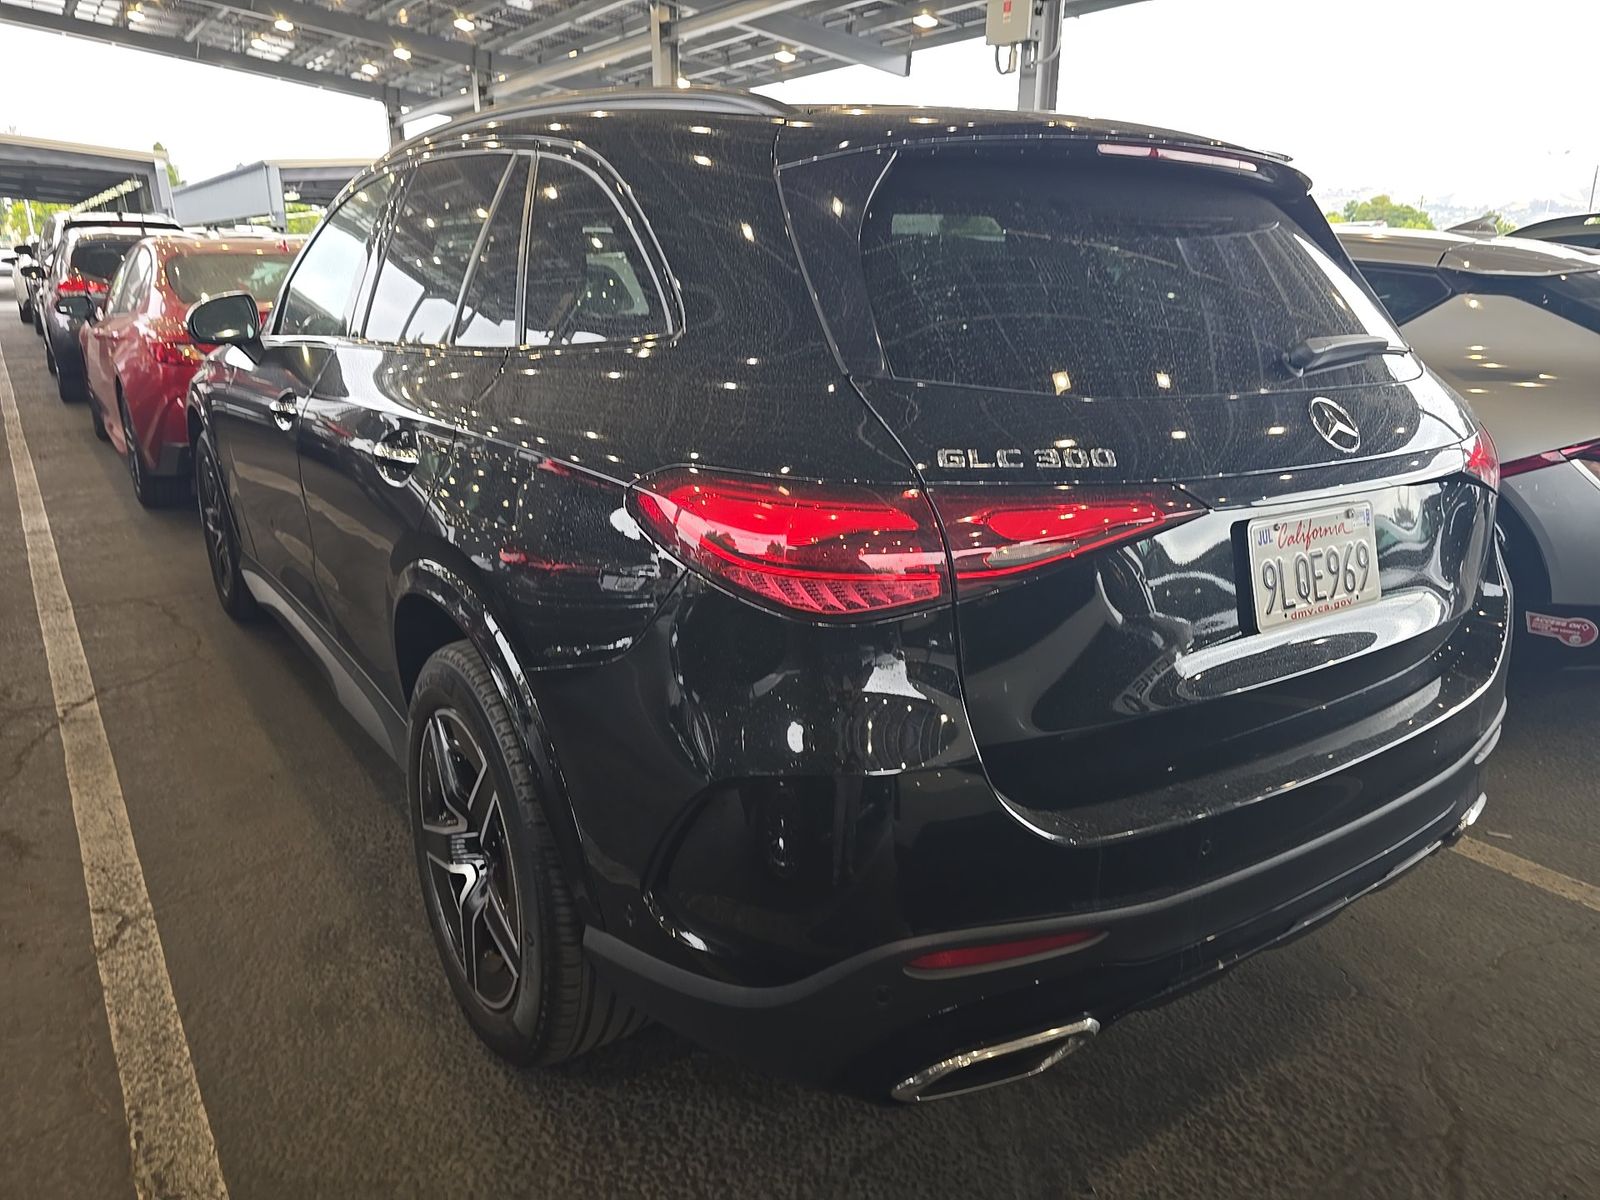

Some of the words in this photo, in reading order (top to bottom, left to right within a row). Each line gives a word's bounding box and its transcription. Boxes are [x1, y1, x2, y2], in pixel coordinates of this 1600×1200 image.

[937, 448, 1024, 468] GLC
[1034, 447, 1118, 468] 300
[1257, 528, 1274, 546] JUL
[1277, 518, 1352, 552] California
[1261, 539, 1370, 616] 9LQE969
[1290, 598, 1353, 620] dmv.ca.gov
